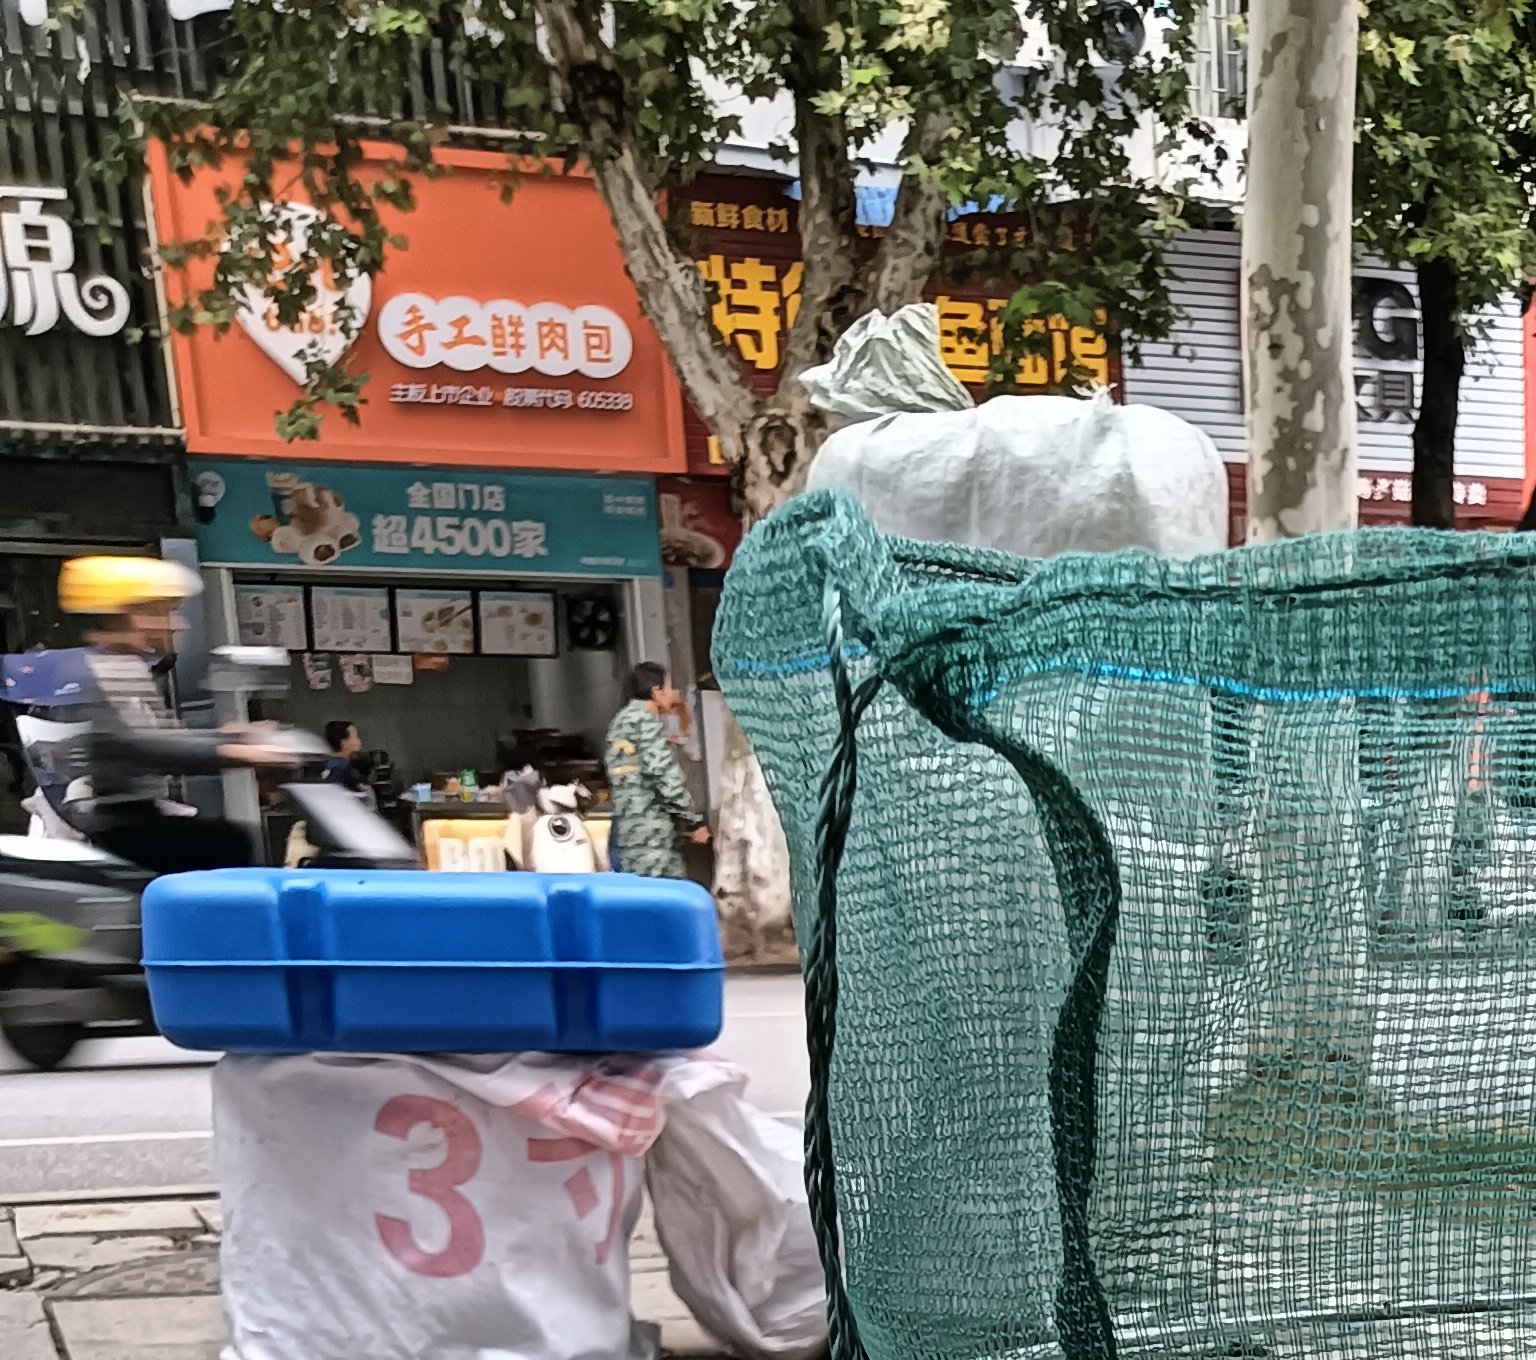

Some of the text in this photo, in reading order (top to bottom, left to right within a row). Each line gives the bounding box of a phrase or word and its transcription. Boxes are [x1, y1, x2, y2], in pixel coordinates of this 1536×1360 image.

[689, 201, 790, 234] 新鲜食材
[394, 303, 613, 364] 手工鲜肉包
[406, 481, 507, 513] 全国门店
[371, 514, 549, 560] 超4500家
[374, 1094, 485, 1278] 3
